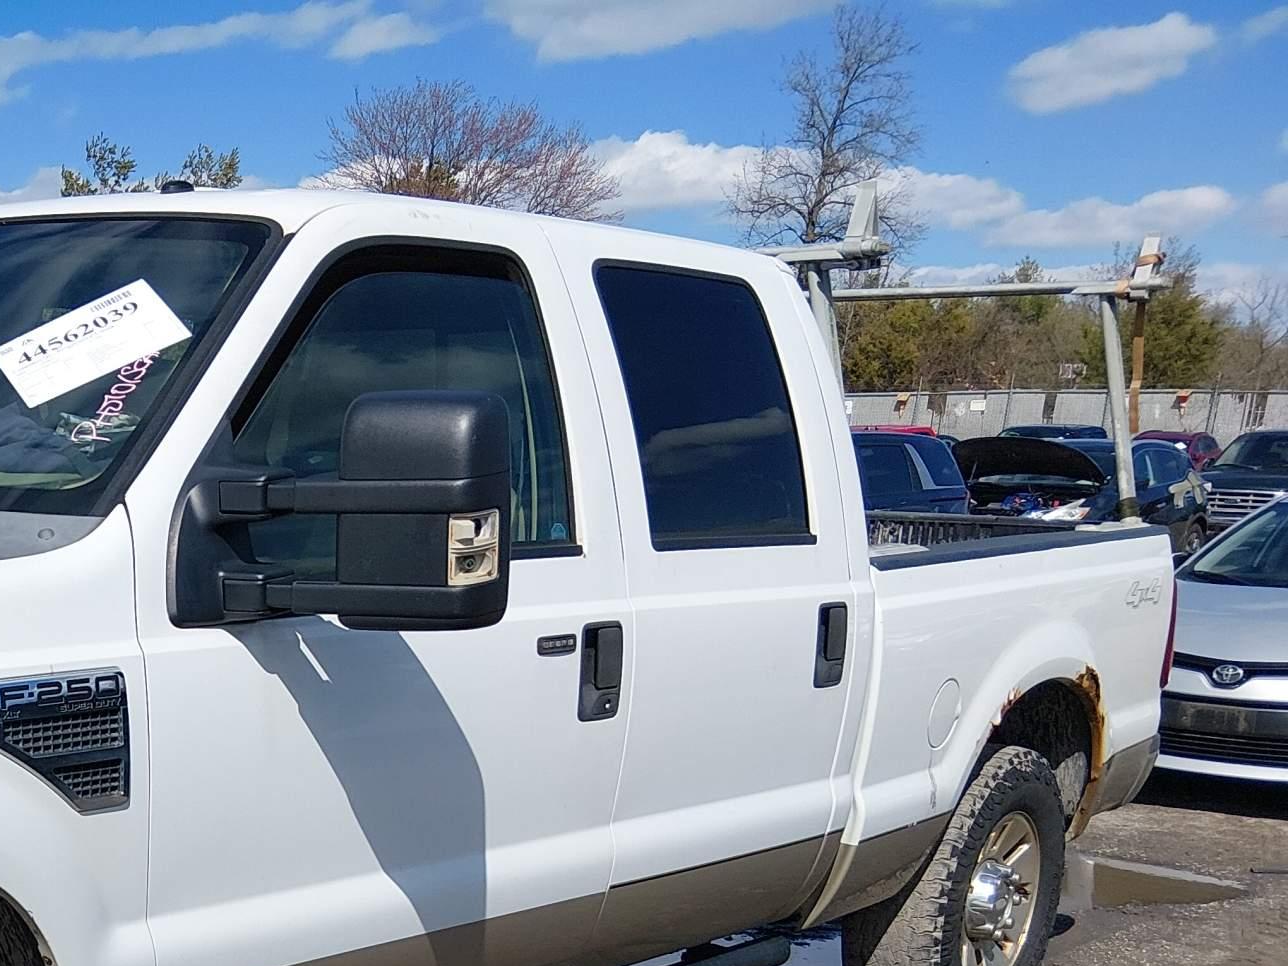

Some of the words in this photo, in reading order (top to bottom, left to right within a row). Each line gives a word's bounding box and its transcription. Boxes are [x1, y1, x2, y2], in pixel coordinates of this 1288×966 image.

[17, 301, 139, 366] 44562039
[70, 350, 161, 442] PHOTO/SCA
[0, 674, 121, 711] F-250
[95, 698, 122, 709] DUTY
